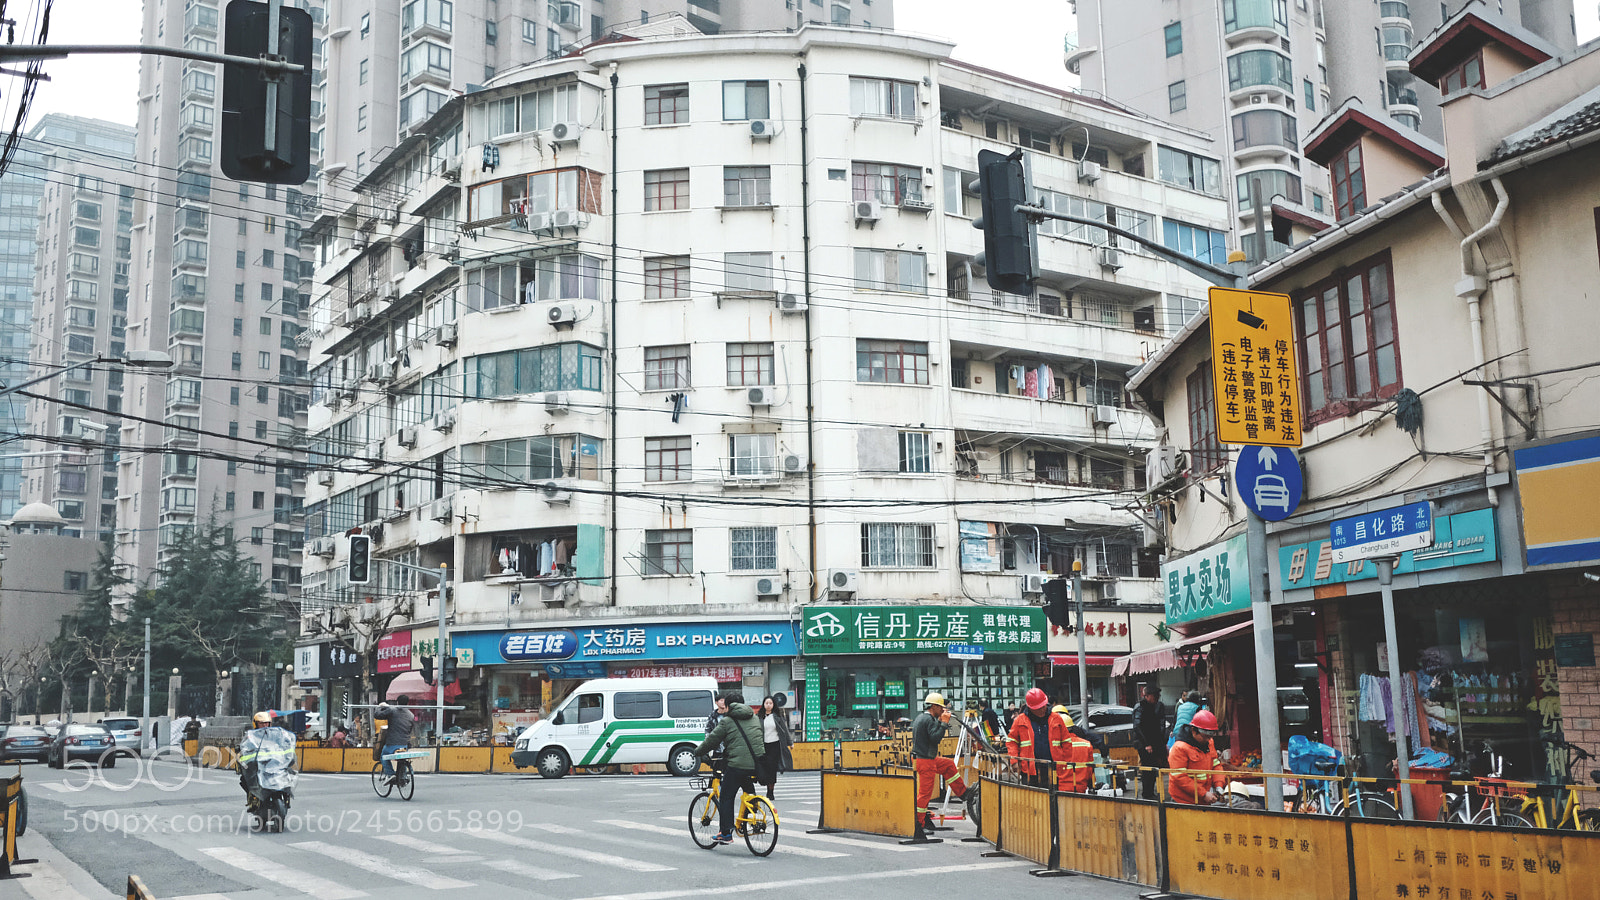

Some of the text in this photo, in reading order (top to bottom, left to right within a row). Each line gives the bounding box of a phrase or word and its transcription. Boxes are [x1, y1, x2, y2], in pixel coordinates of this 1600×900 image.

[1240, 336, 1258, 439] 电子警察监管
[1257, 347, 1275, 431] 请立即驶离
[1275, 339, 1295, 441] 停车行为违法
[1416, 508, 1425, 519] 北
[1335, 526, 1343, 536] 南
[1355, 513, 1405, 541] 昌化路
[1334, 537, 1347, 546] 1013
[1419, 535, 1425, 544] N
[1457, 535, 1485, 547] BUDIAN
[1360, 541, 1400, 554] Changhua Rd
[1338, 552, 1344, 560] S
[1168, 552, 1231, 618] 果大卖场
[983, 614, 1031, 627] 租售代理
[582, 628, 646, 648] 大药房
[656, 633, 783, 647] LBX PHARMACY
[972, 630, 1042, 644] 全市各类房源
[505, 635, 565, 655] 老百姓
[600, 647, 646, 655] PHARMACY
[1195, 831, 1310, 853] 上海普陀市政建设
[1394, 849, 1562, 874] 上海普陀市政建设
[1197, 861, 1280, 881] 养护有限公司
